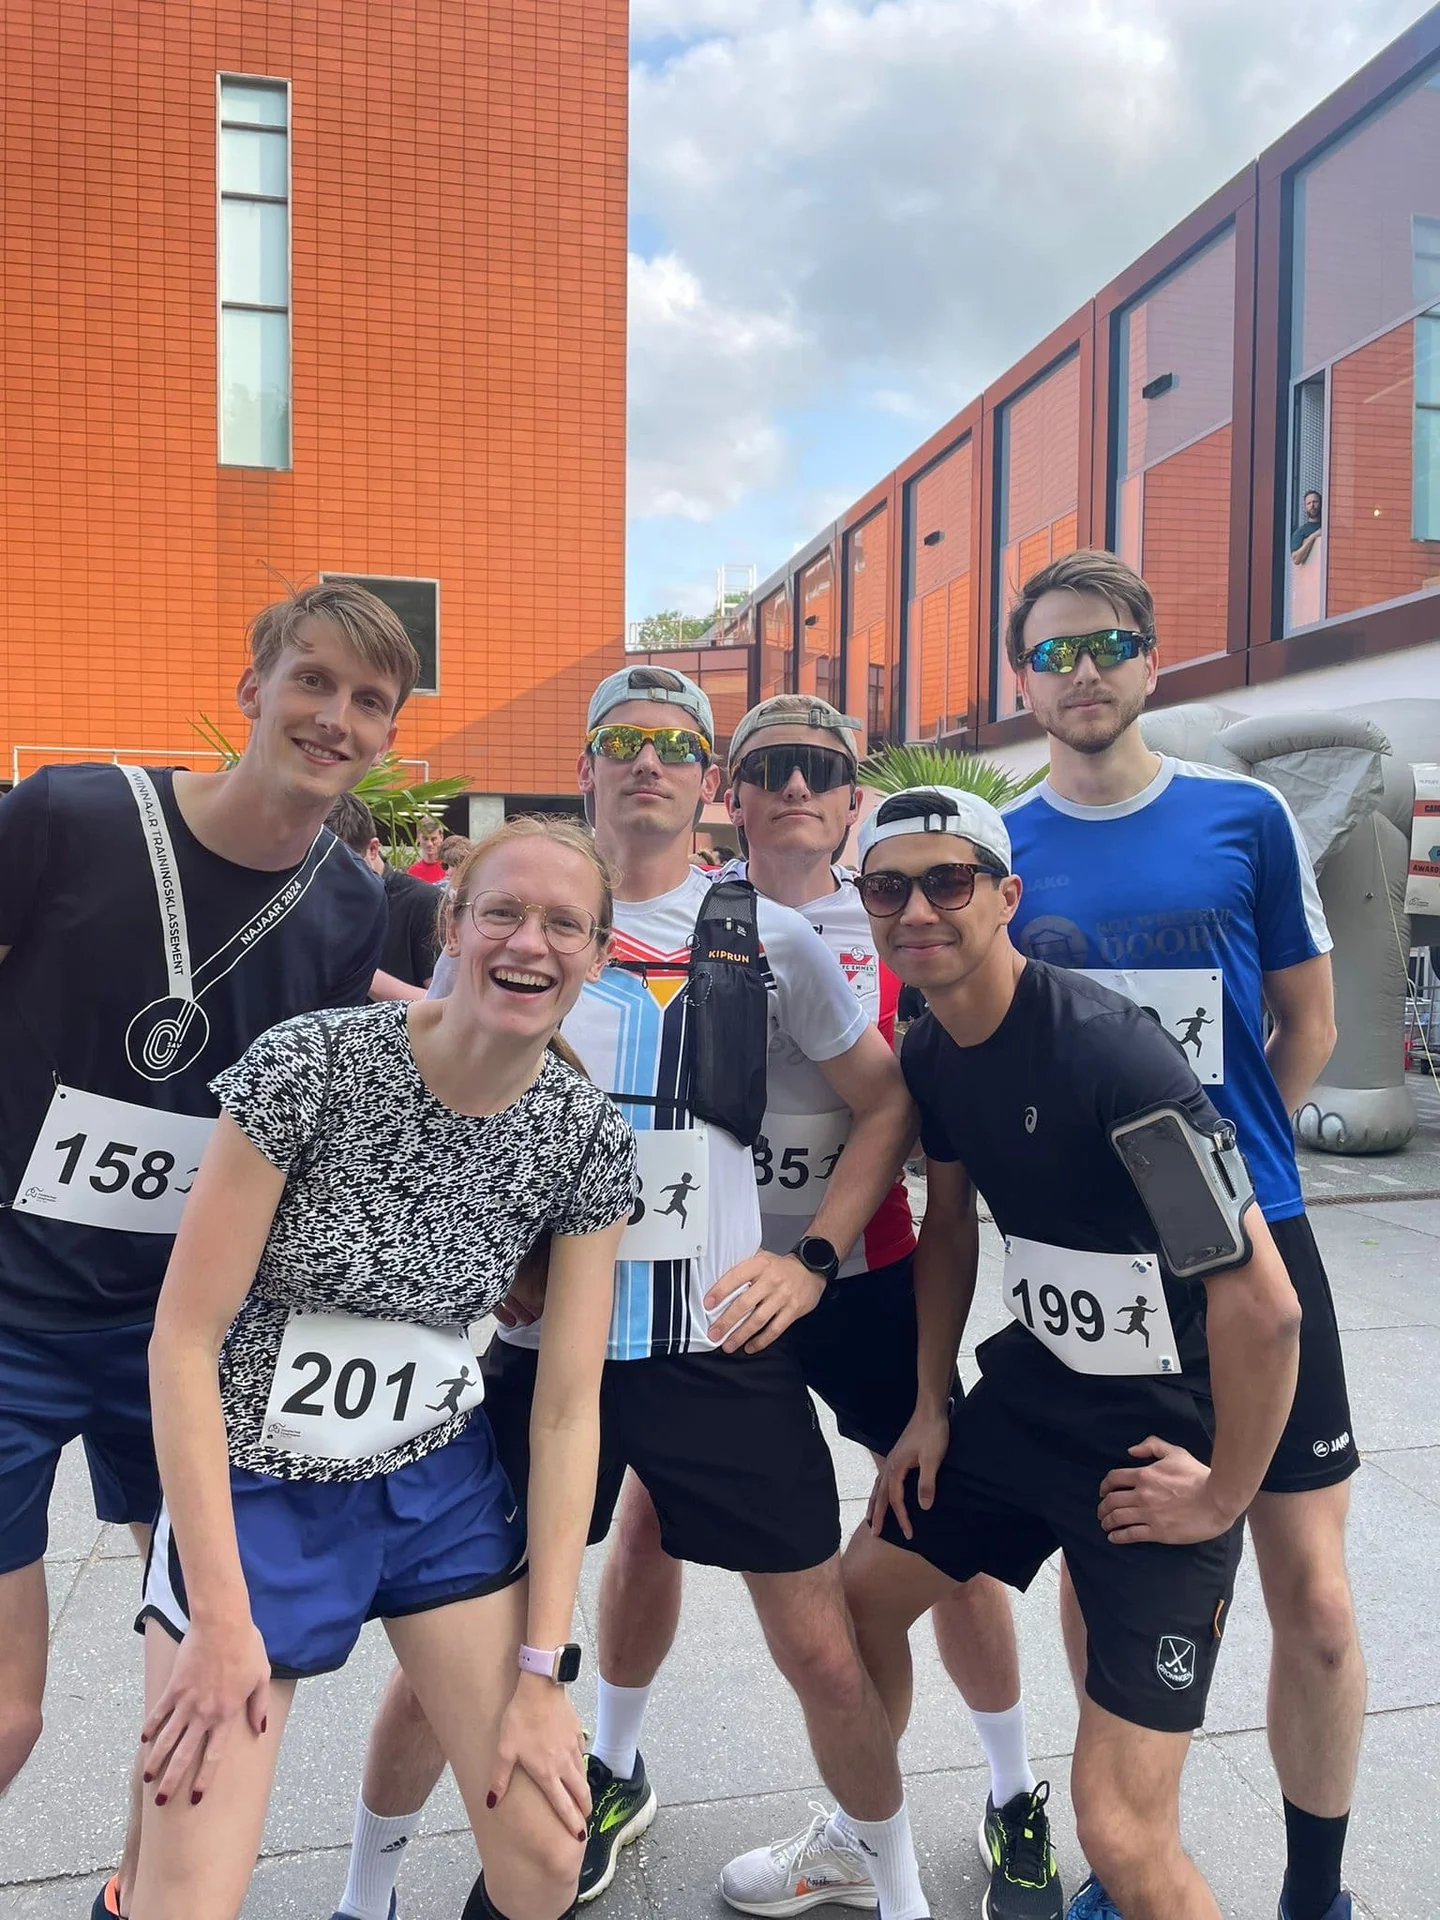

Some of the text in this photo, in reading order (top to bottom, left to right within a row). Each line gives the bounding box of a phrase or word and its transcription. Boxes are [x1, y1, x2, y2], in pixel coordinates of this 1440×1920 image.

[131, 772, 184, 976] WINNAAR TRAININGSKLASSEMENT
[240, 880, 302, 945] NAJAAR 2024
[708, 950, 750, 964] KIPRUN
[55, 1132, 175, 1200] 158
[1012, 1278, 1105, 1342] 199
[280, 1351, 417, 1422] 201
[1331, 1431, 1350, 1452] JAKO
